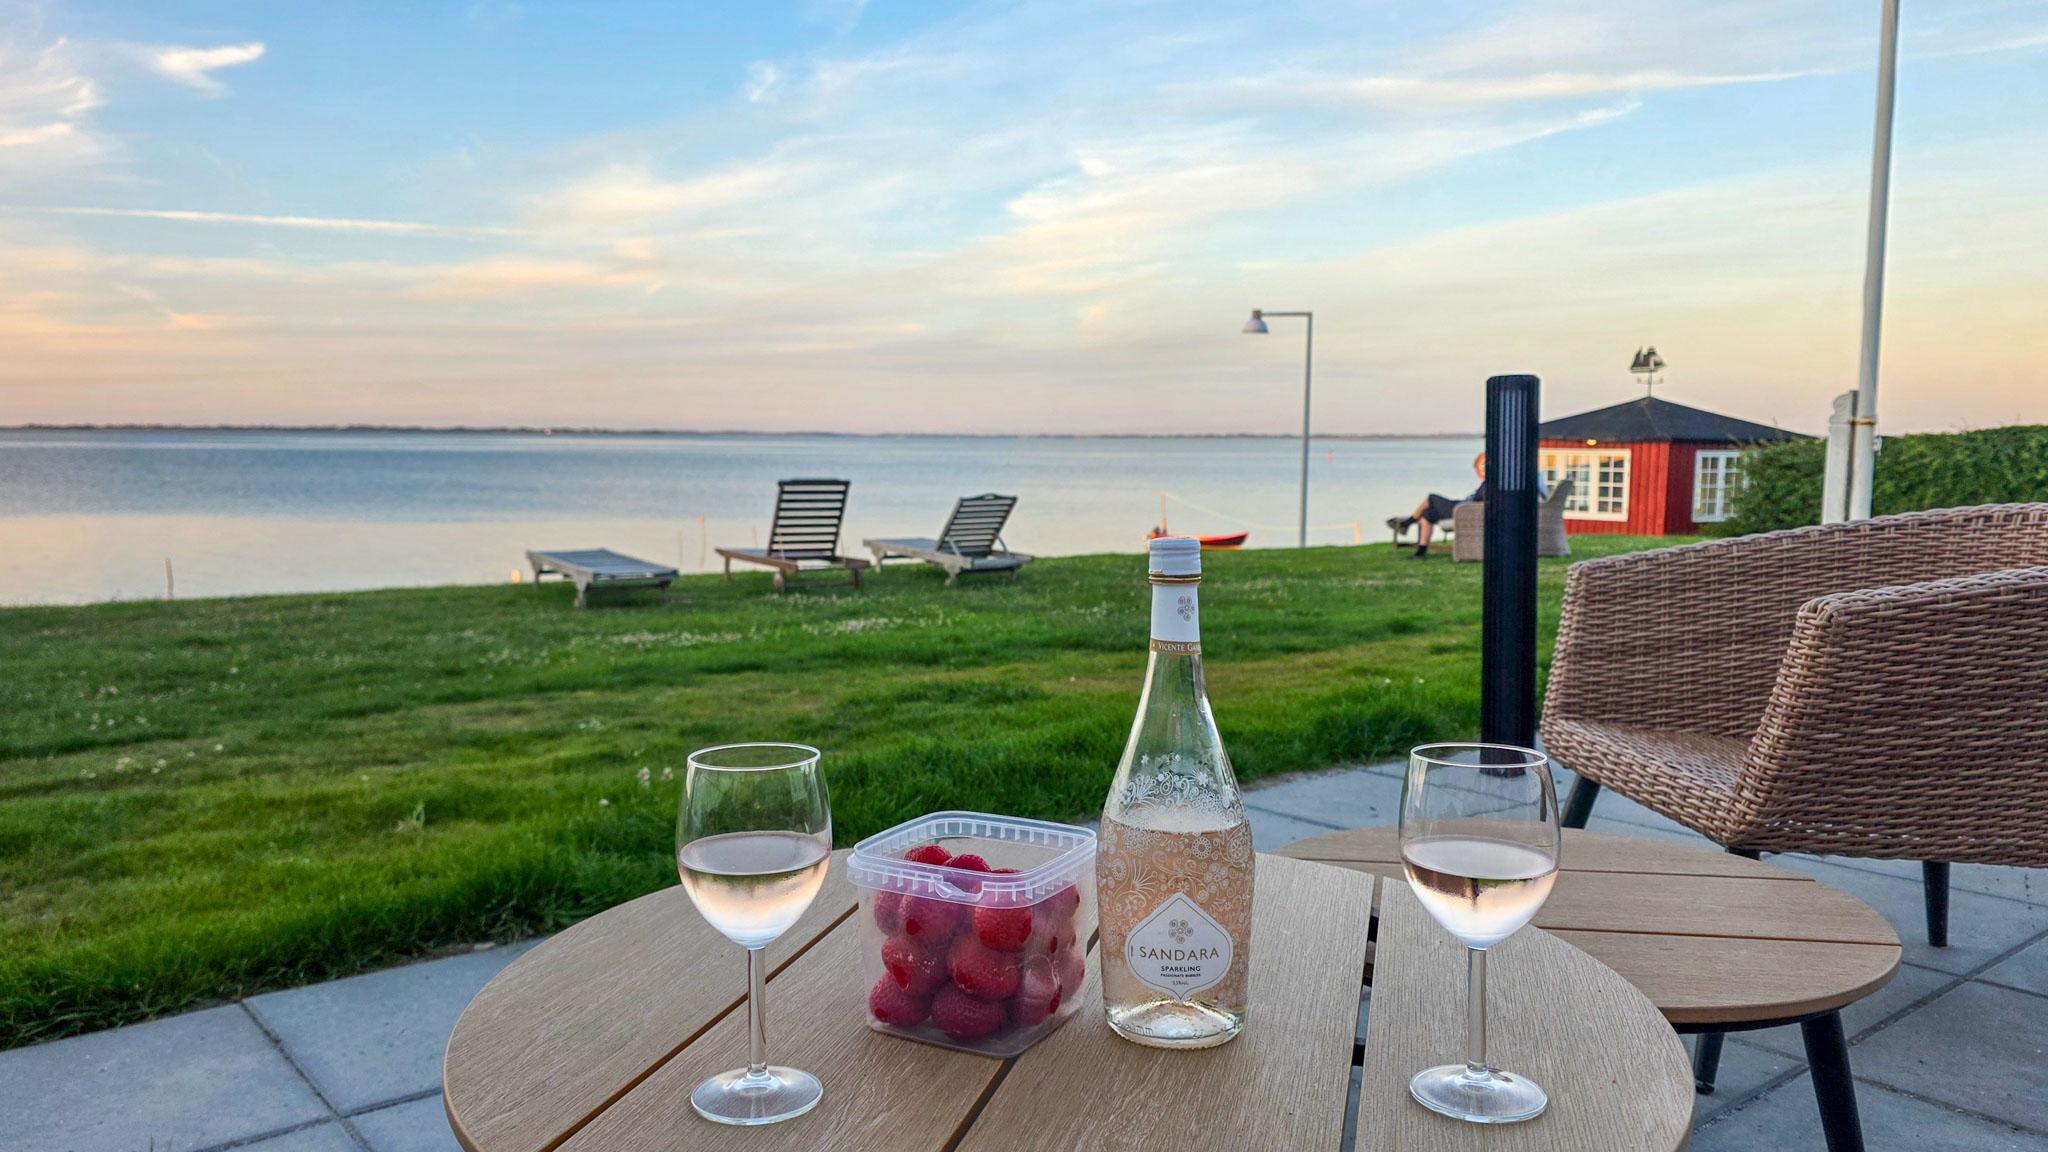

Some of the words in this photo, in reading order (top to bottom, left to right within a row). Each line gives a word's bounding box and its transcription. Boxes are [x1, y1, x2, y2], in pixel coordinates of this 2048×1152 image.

[1158, 641, 1185, 651] VICENTE
[1139, 946, 1219, 961] SANDARA
[1160, 965, 1201, 973] SPARKLING
